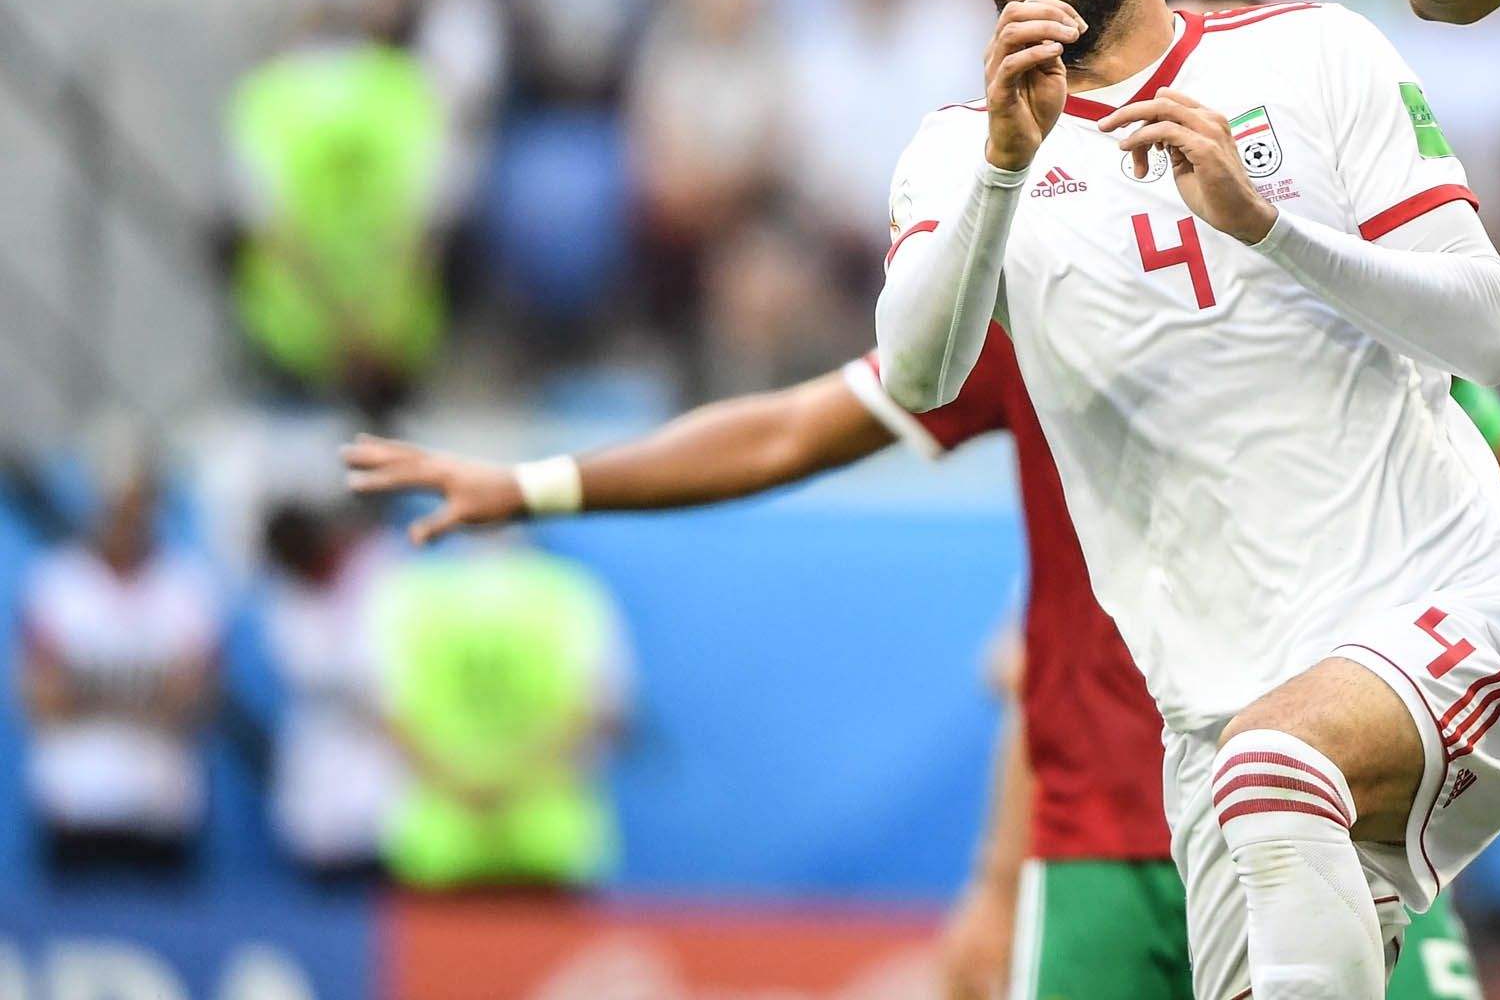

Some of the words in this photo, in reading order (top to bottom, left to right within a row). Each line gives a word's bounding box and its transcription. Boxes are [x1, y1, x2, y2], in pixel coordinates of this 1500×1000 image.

[1030, 179, 1087, 199] adidas
[1131, 213, 1216, 309] 4
[1413, 606, 1477, 680] 4
